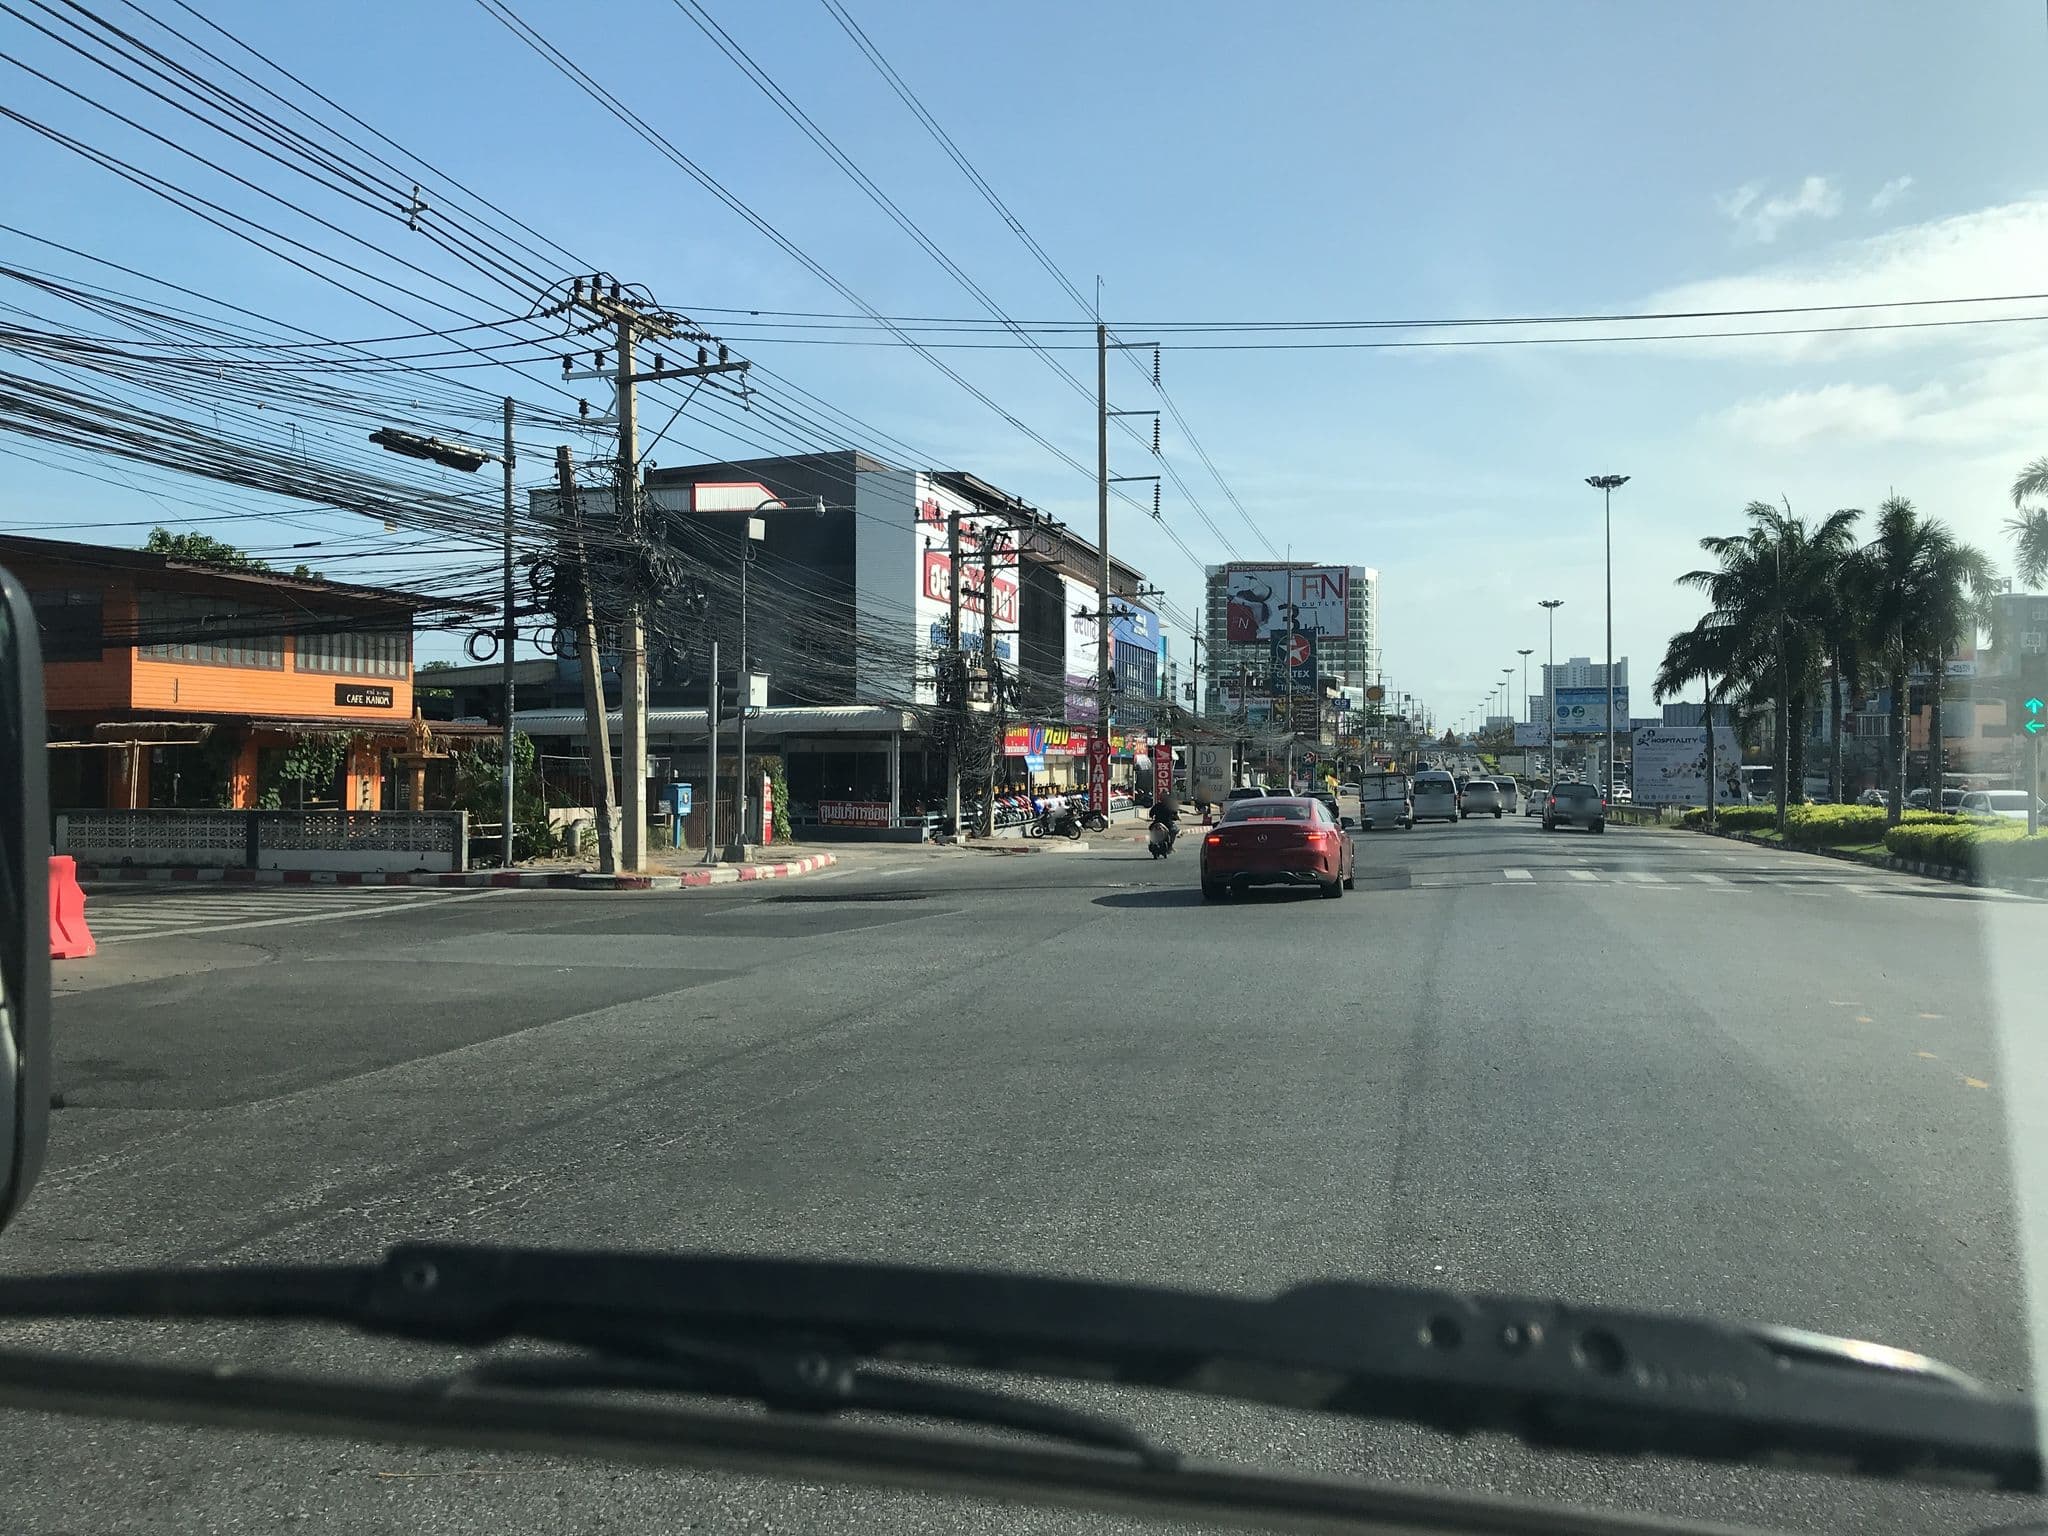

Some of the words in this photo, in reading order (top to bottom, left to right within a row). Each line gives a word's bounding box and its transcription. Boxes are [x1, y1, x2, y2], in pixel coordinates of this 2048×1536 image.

[1278, 602, 1300, 634] 3
[346, 694, 364, 704] CAFE
[365, 695, 390, 705] KANOM
[1092, 754, 1105, 811] YAMAHA
